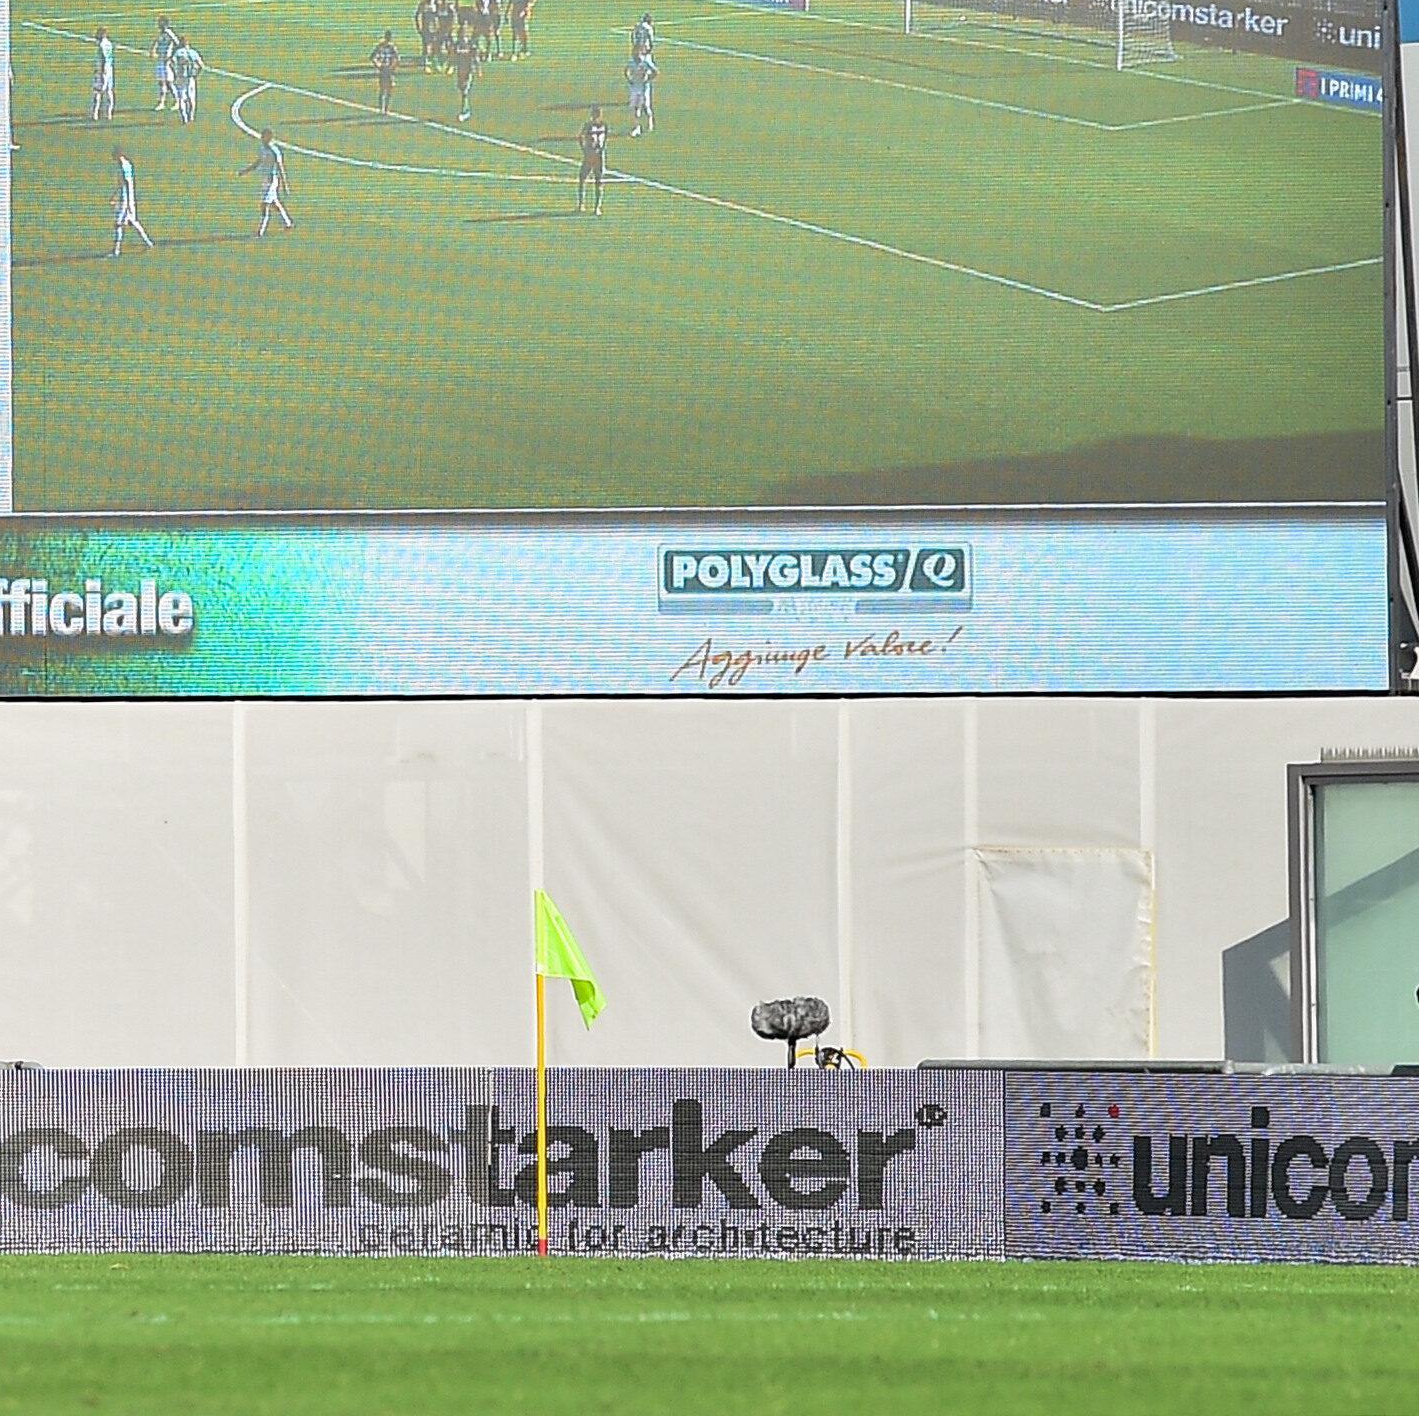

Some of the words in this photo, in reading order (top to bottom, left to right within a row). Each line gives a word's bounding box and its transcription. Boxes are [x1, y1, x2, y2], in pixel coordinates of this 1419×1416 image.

[1339, 25, 1381, 50] uni
[1328, 80, 1373, 102] PRIMI
[672, 554, 897, 589] POLYGLASS
[567, 1219, 624, 1252] for
[647, 1218, 917, 1254] architecture
